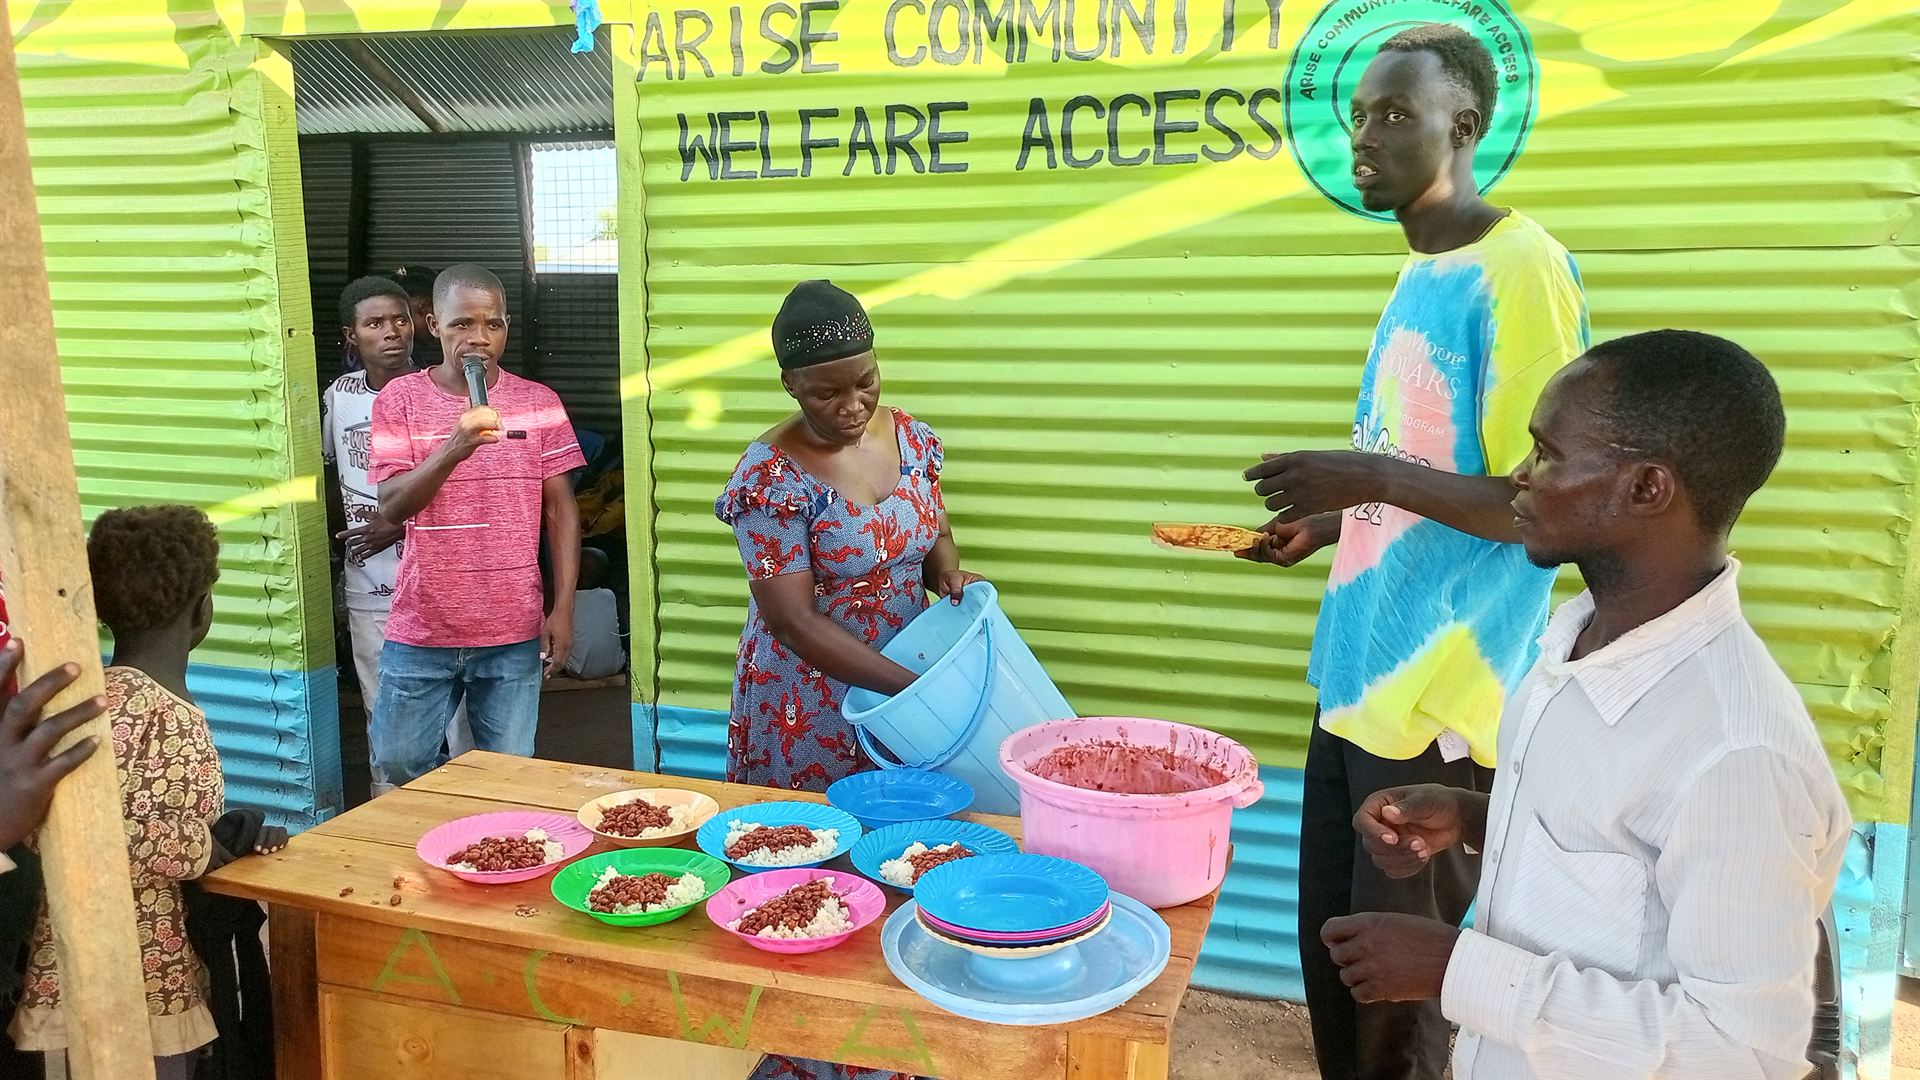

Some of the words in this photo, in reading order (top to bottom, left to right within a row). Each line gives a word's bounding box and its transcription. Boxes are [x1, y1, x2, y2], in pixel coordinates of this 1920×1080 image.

[636, 0, 839, 82] ARISE
[1300, 52, 1321, 100] ARISE
[1318, 0, 1406, 49] COMMUN
[1486, 25, 1519, 84] ACCESS
[677, 101, 968, 182] WELFARE
[1017, 89, 1282, 171] ACCESS
[1399, 414, 1447, 438] ROGRAM
